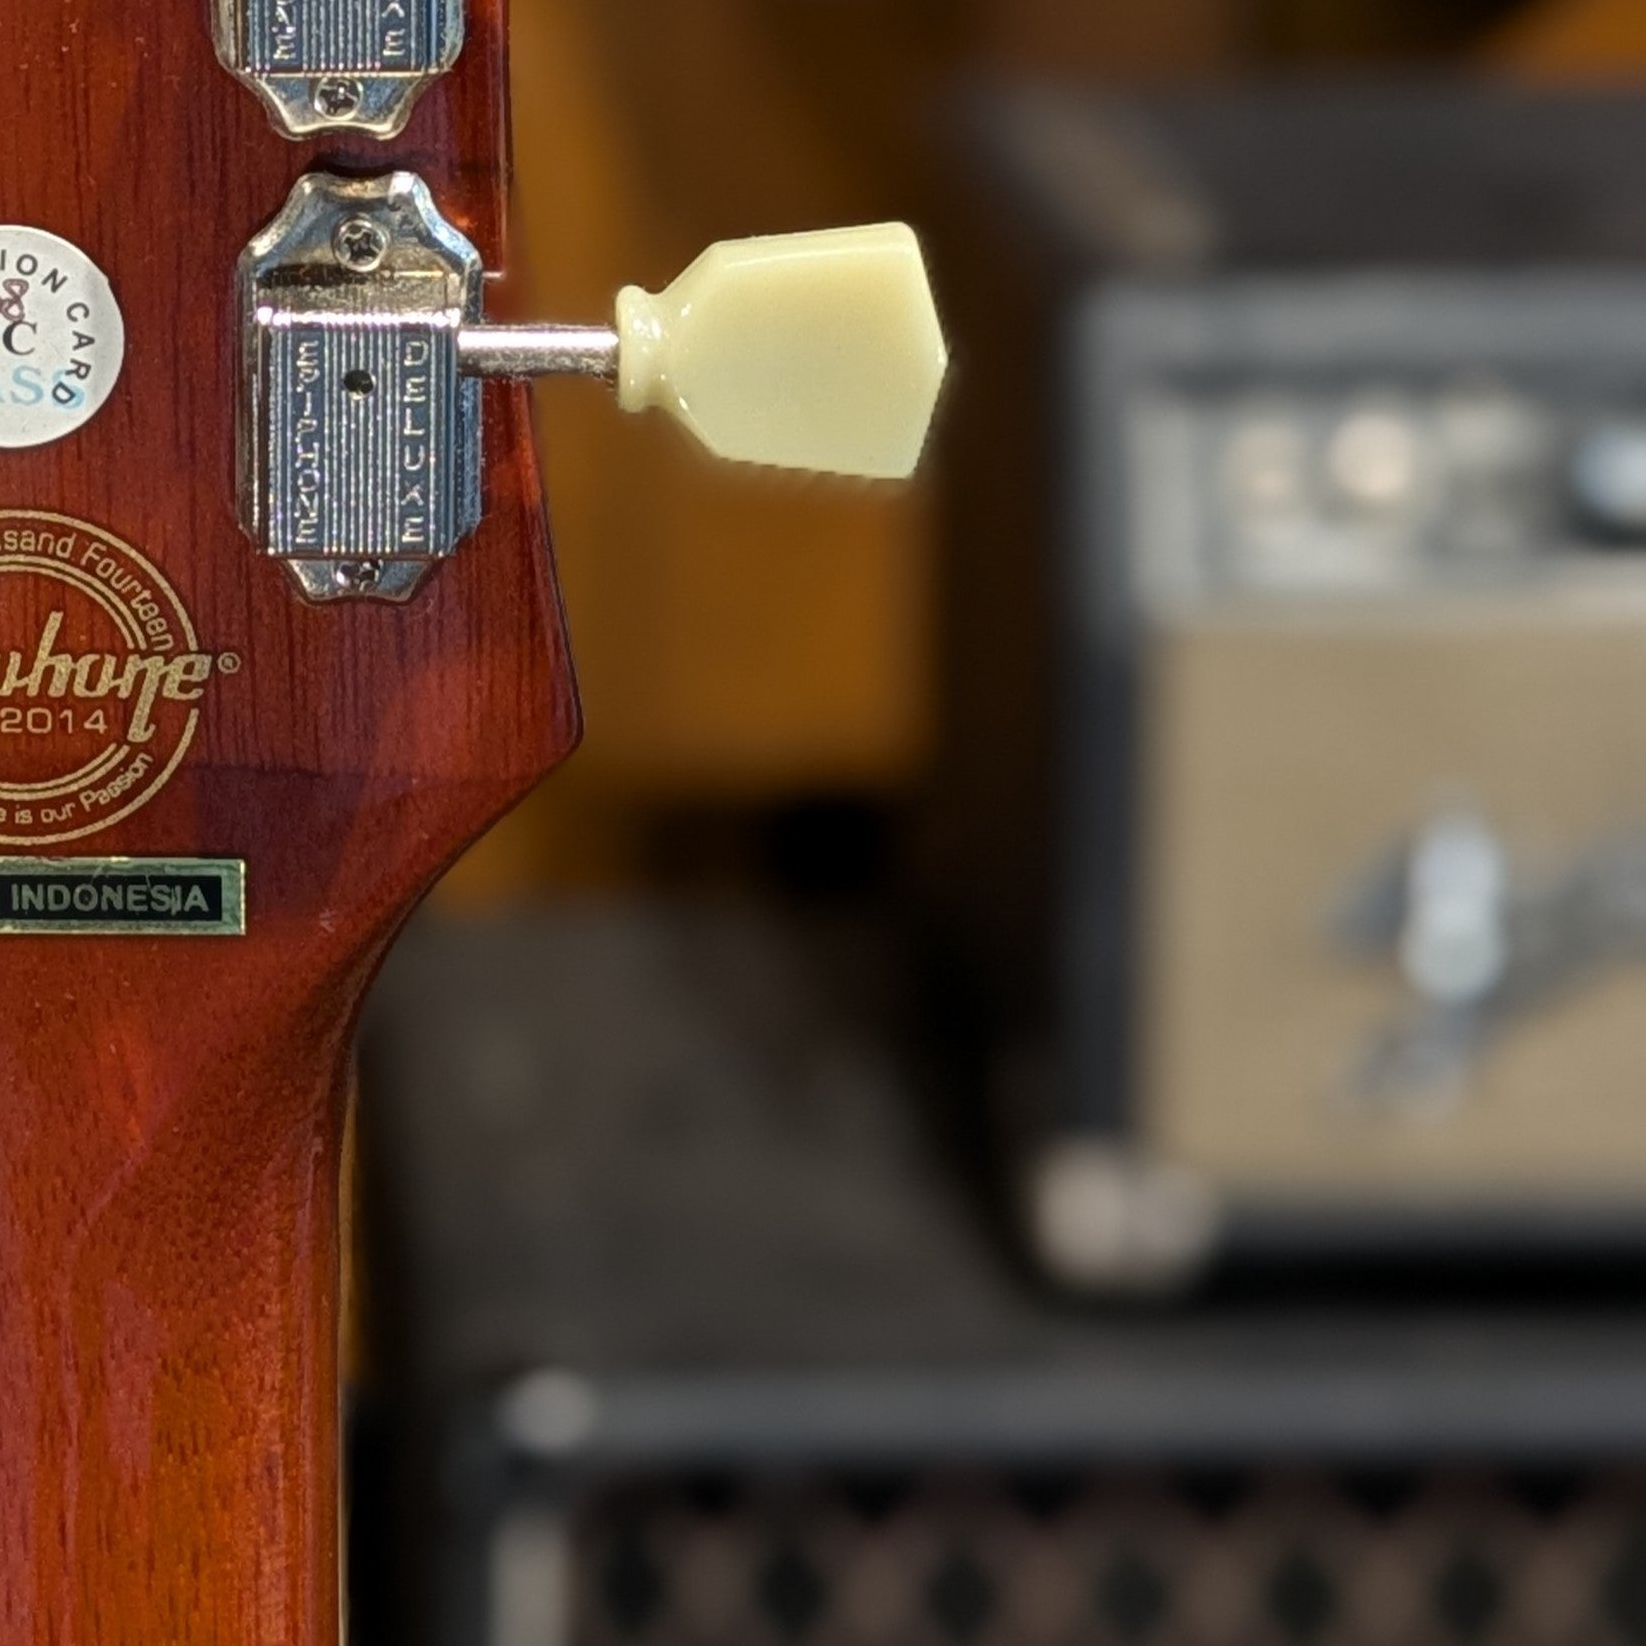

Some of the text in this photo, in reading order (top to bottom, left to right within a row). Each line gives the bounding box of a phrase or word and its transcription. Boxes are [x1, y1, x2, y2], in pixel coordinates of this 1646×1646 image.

[51, 302, 96, 405] CARD
[400, 339, 430, 542] DELUXE
[80, 541, 175, 652] Fourteen
[0, 707, 108, 736] 2014
[14, 804, 34, 824] is
[40, 804, 76, 824] our
[79, 752, 154, 812] Passion
[11, 882, 210, 914] INDONESIA
